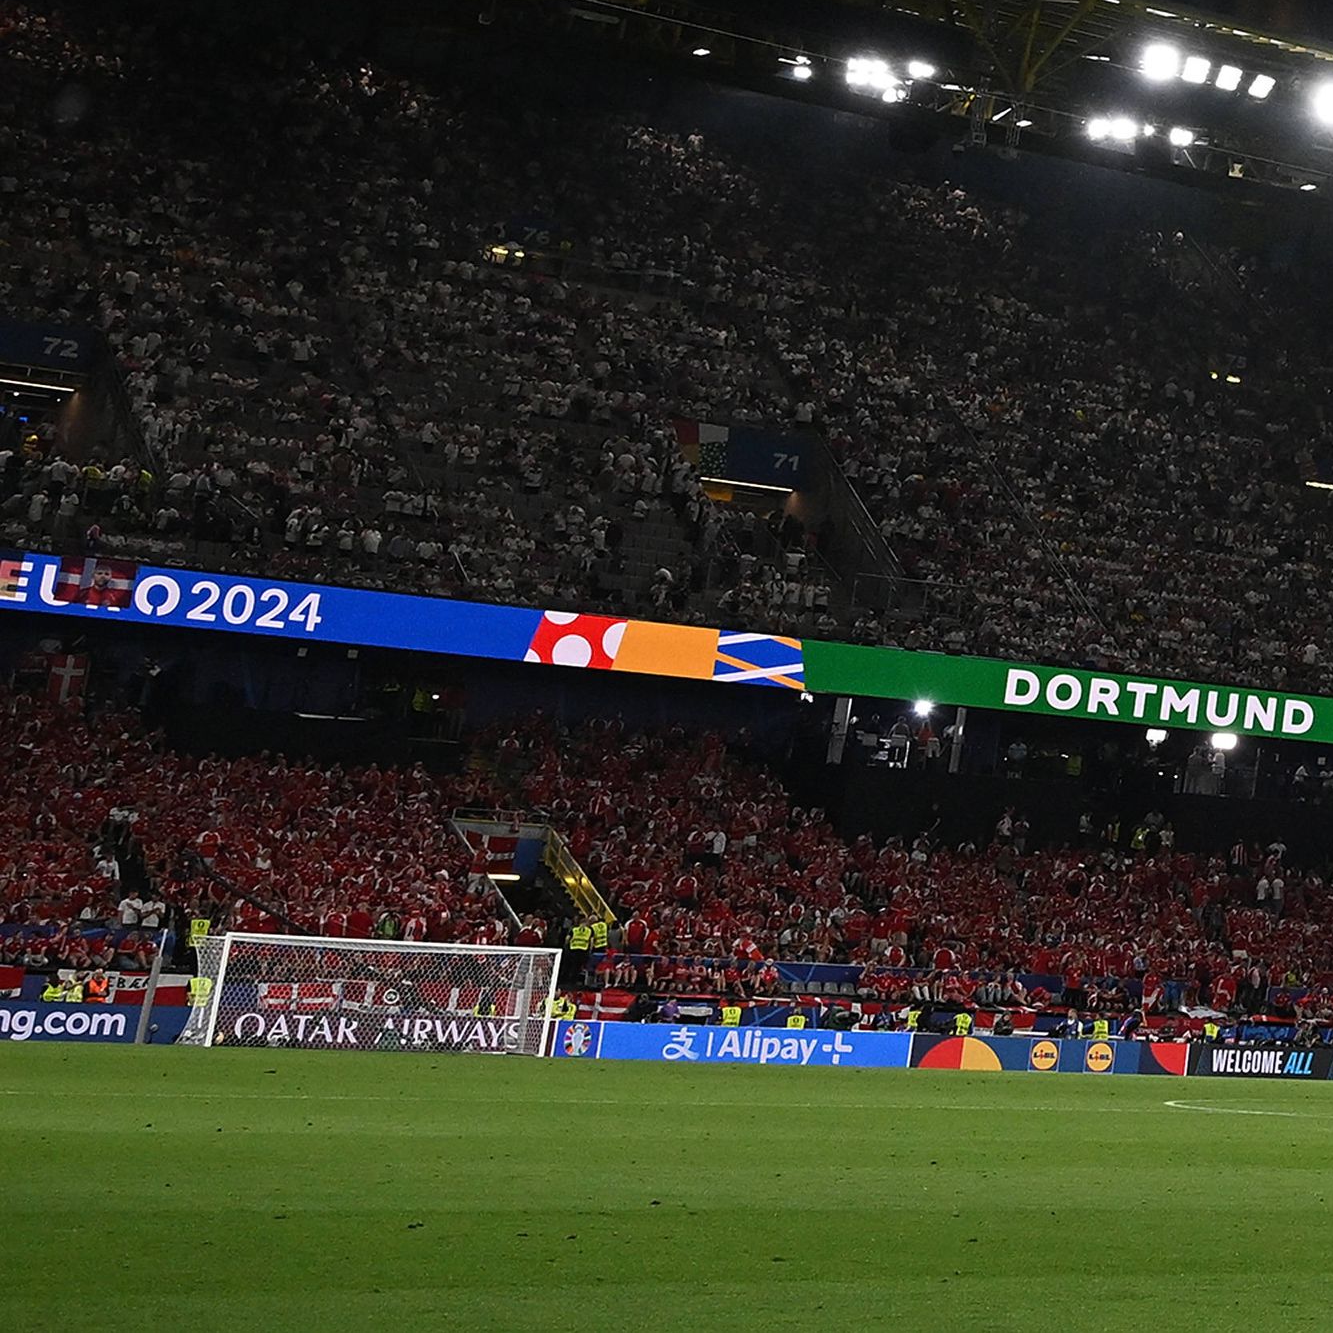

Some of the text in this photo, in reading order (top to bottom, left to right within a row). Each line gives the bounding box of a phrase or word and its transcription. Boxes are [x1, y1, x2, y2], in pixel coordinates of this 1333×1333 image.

[43, 336, 79, 358] 72
[773, 453, 800, 471] 71
[1003, 668, 1315, 734] DORTMUND
[234, 1013, 520, 1049] QATAR AIRWAYS
[718, 1031, 816, 1065] Alipay
[1212, 1049, 1313, 1075] WELCOME ALL
